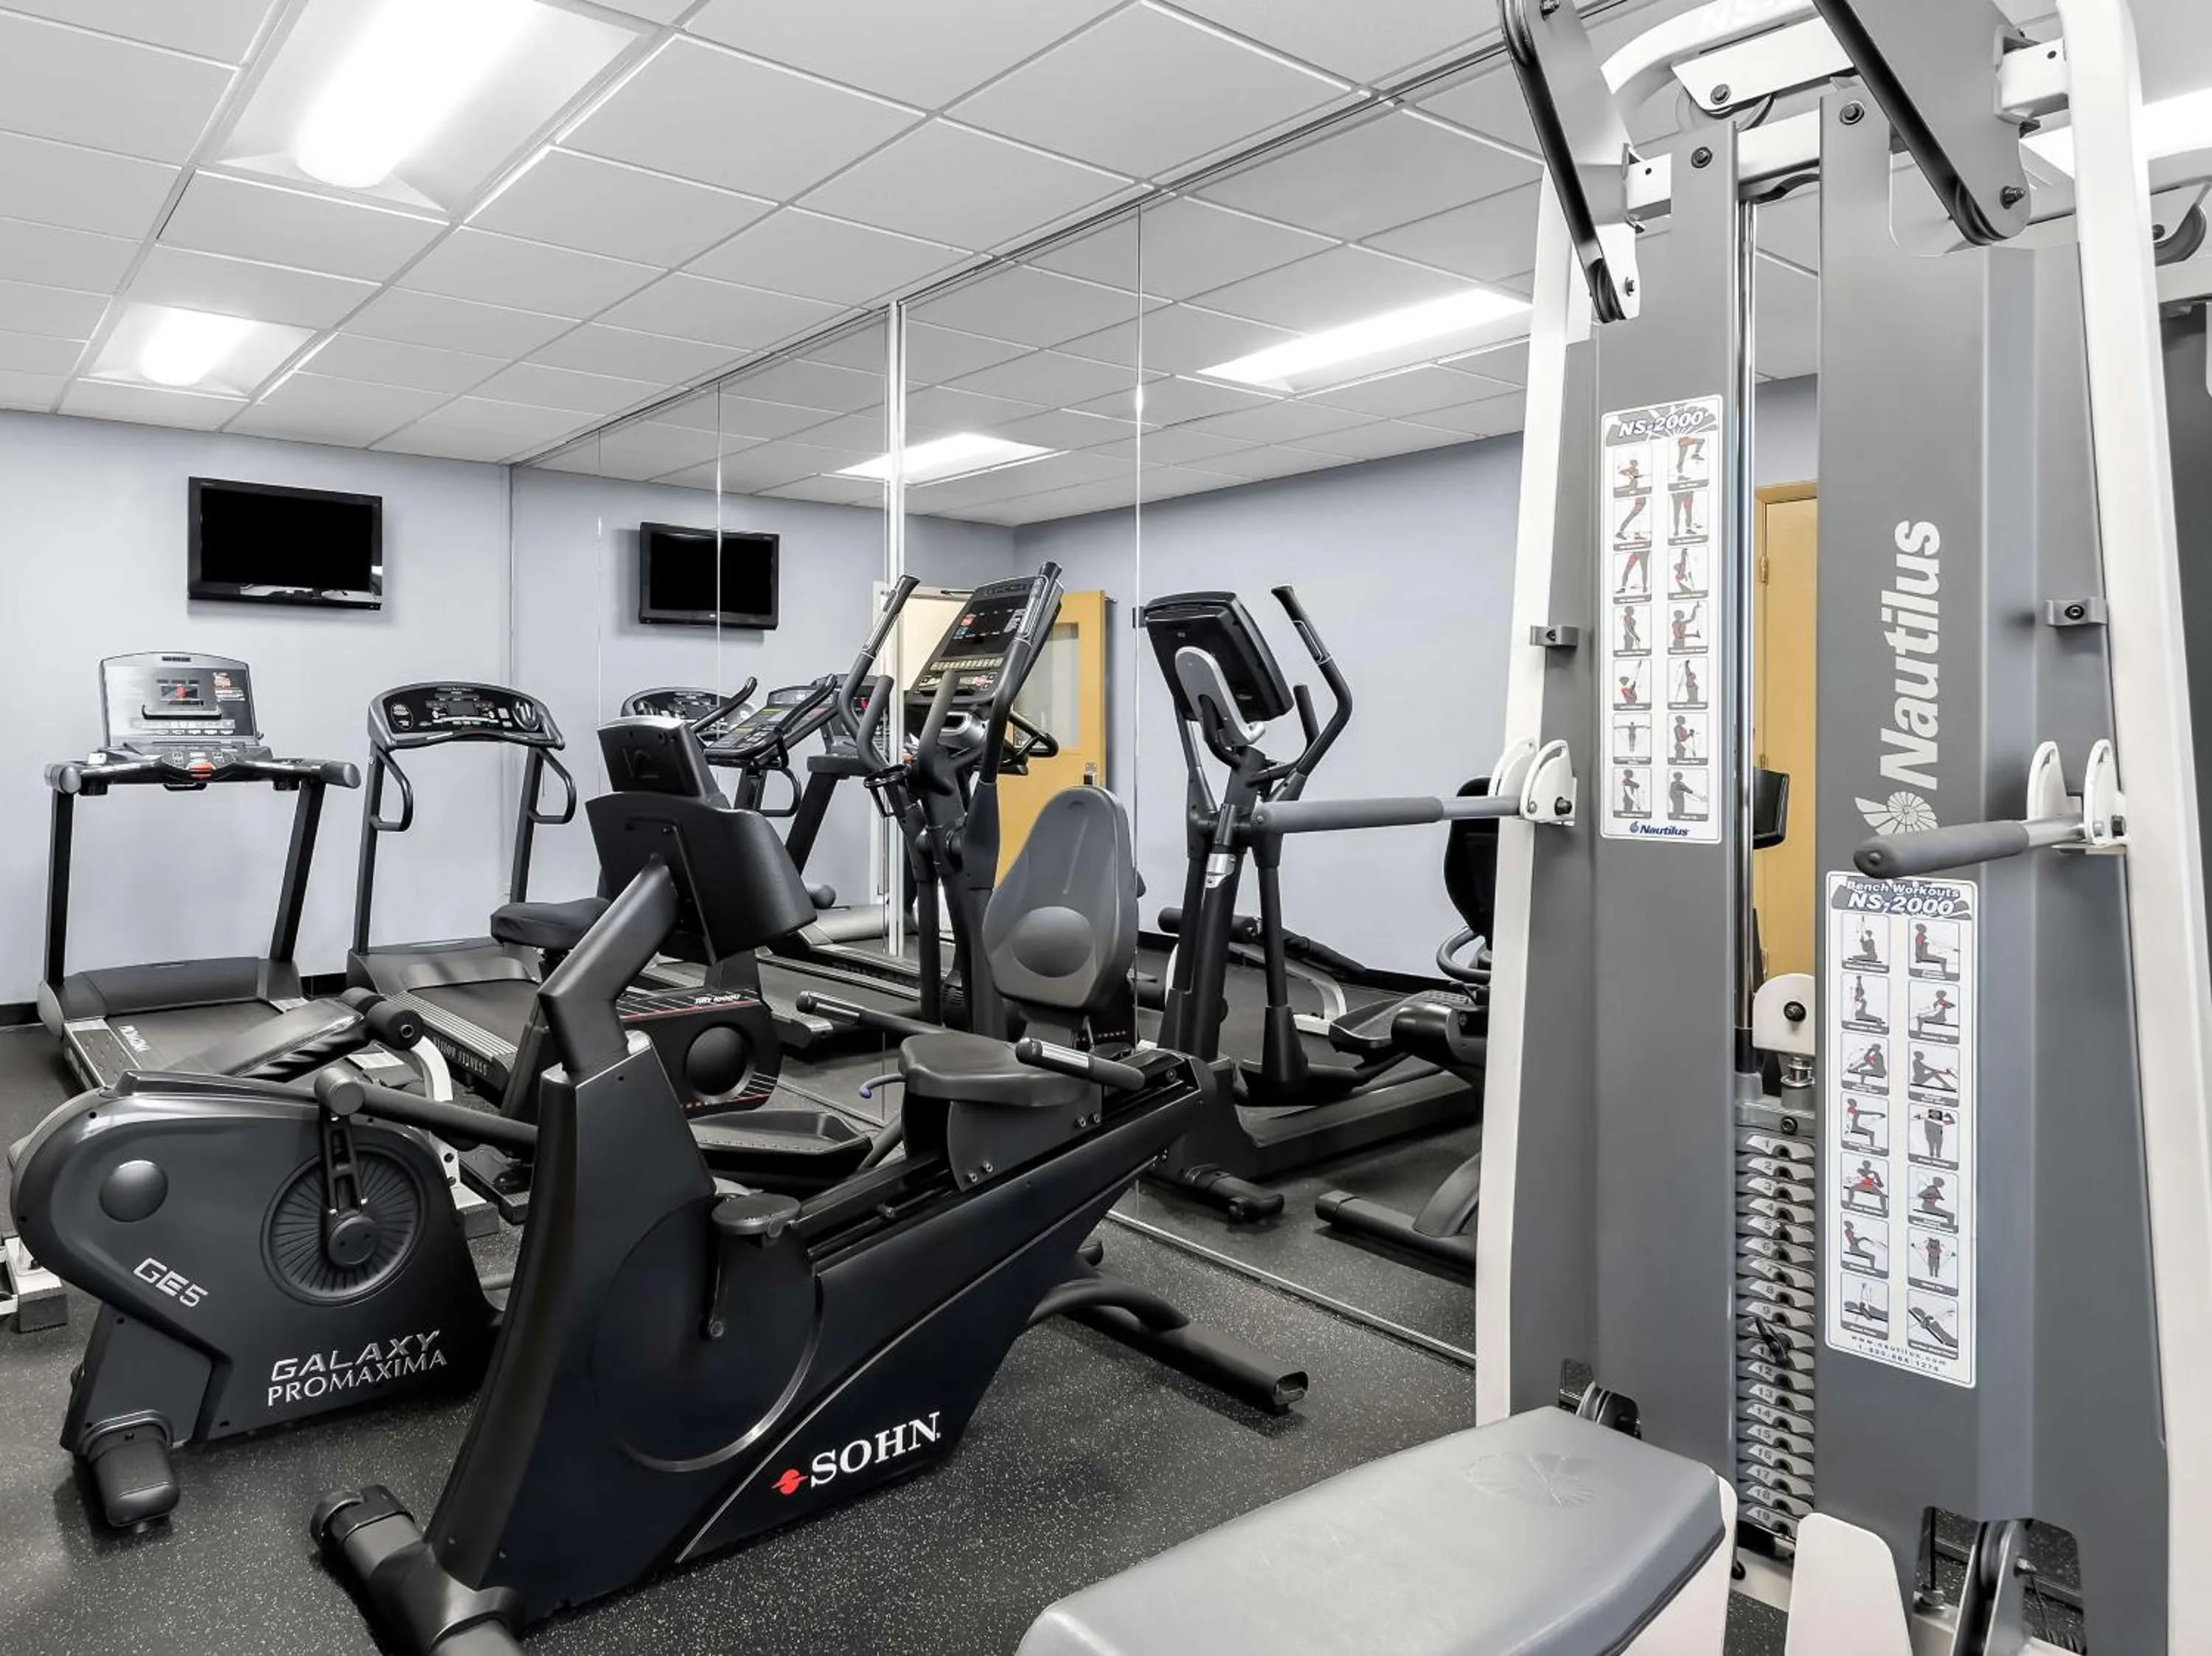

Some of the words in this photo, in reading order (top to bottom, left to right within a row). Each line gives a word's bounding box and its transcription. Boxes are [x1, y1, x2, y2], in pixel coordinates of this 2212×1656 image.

[1618, 411, 1704, 438] NS-2000
[1880, 520, 1941, 790] Nautilus
[1639, 824, 1689, 837] Nautilus
[1847, 891, 1955, 916] NS-2000
[1892, 883, 1960, 898] Workouts
[133, 1256, 209, 1309] GE5
[267, 1349, 448, 1407] PROMAXIMA
[271, 1329, 440, 1382] GALAXY
[810, 1410, 941, 1489] SOHN
